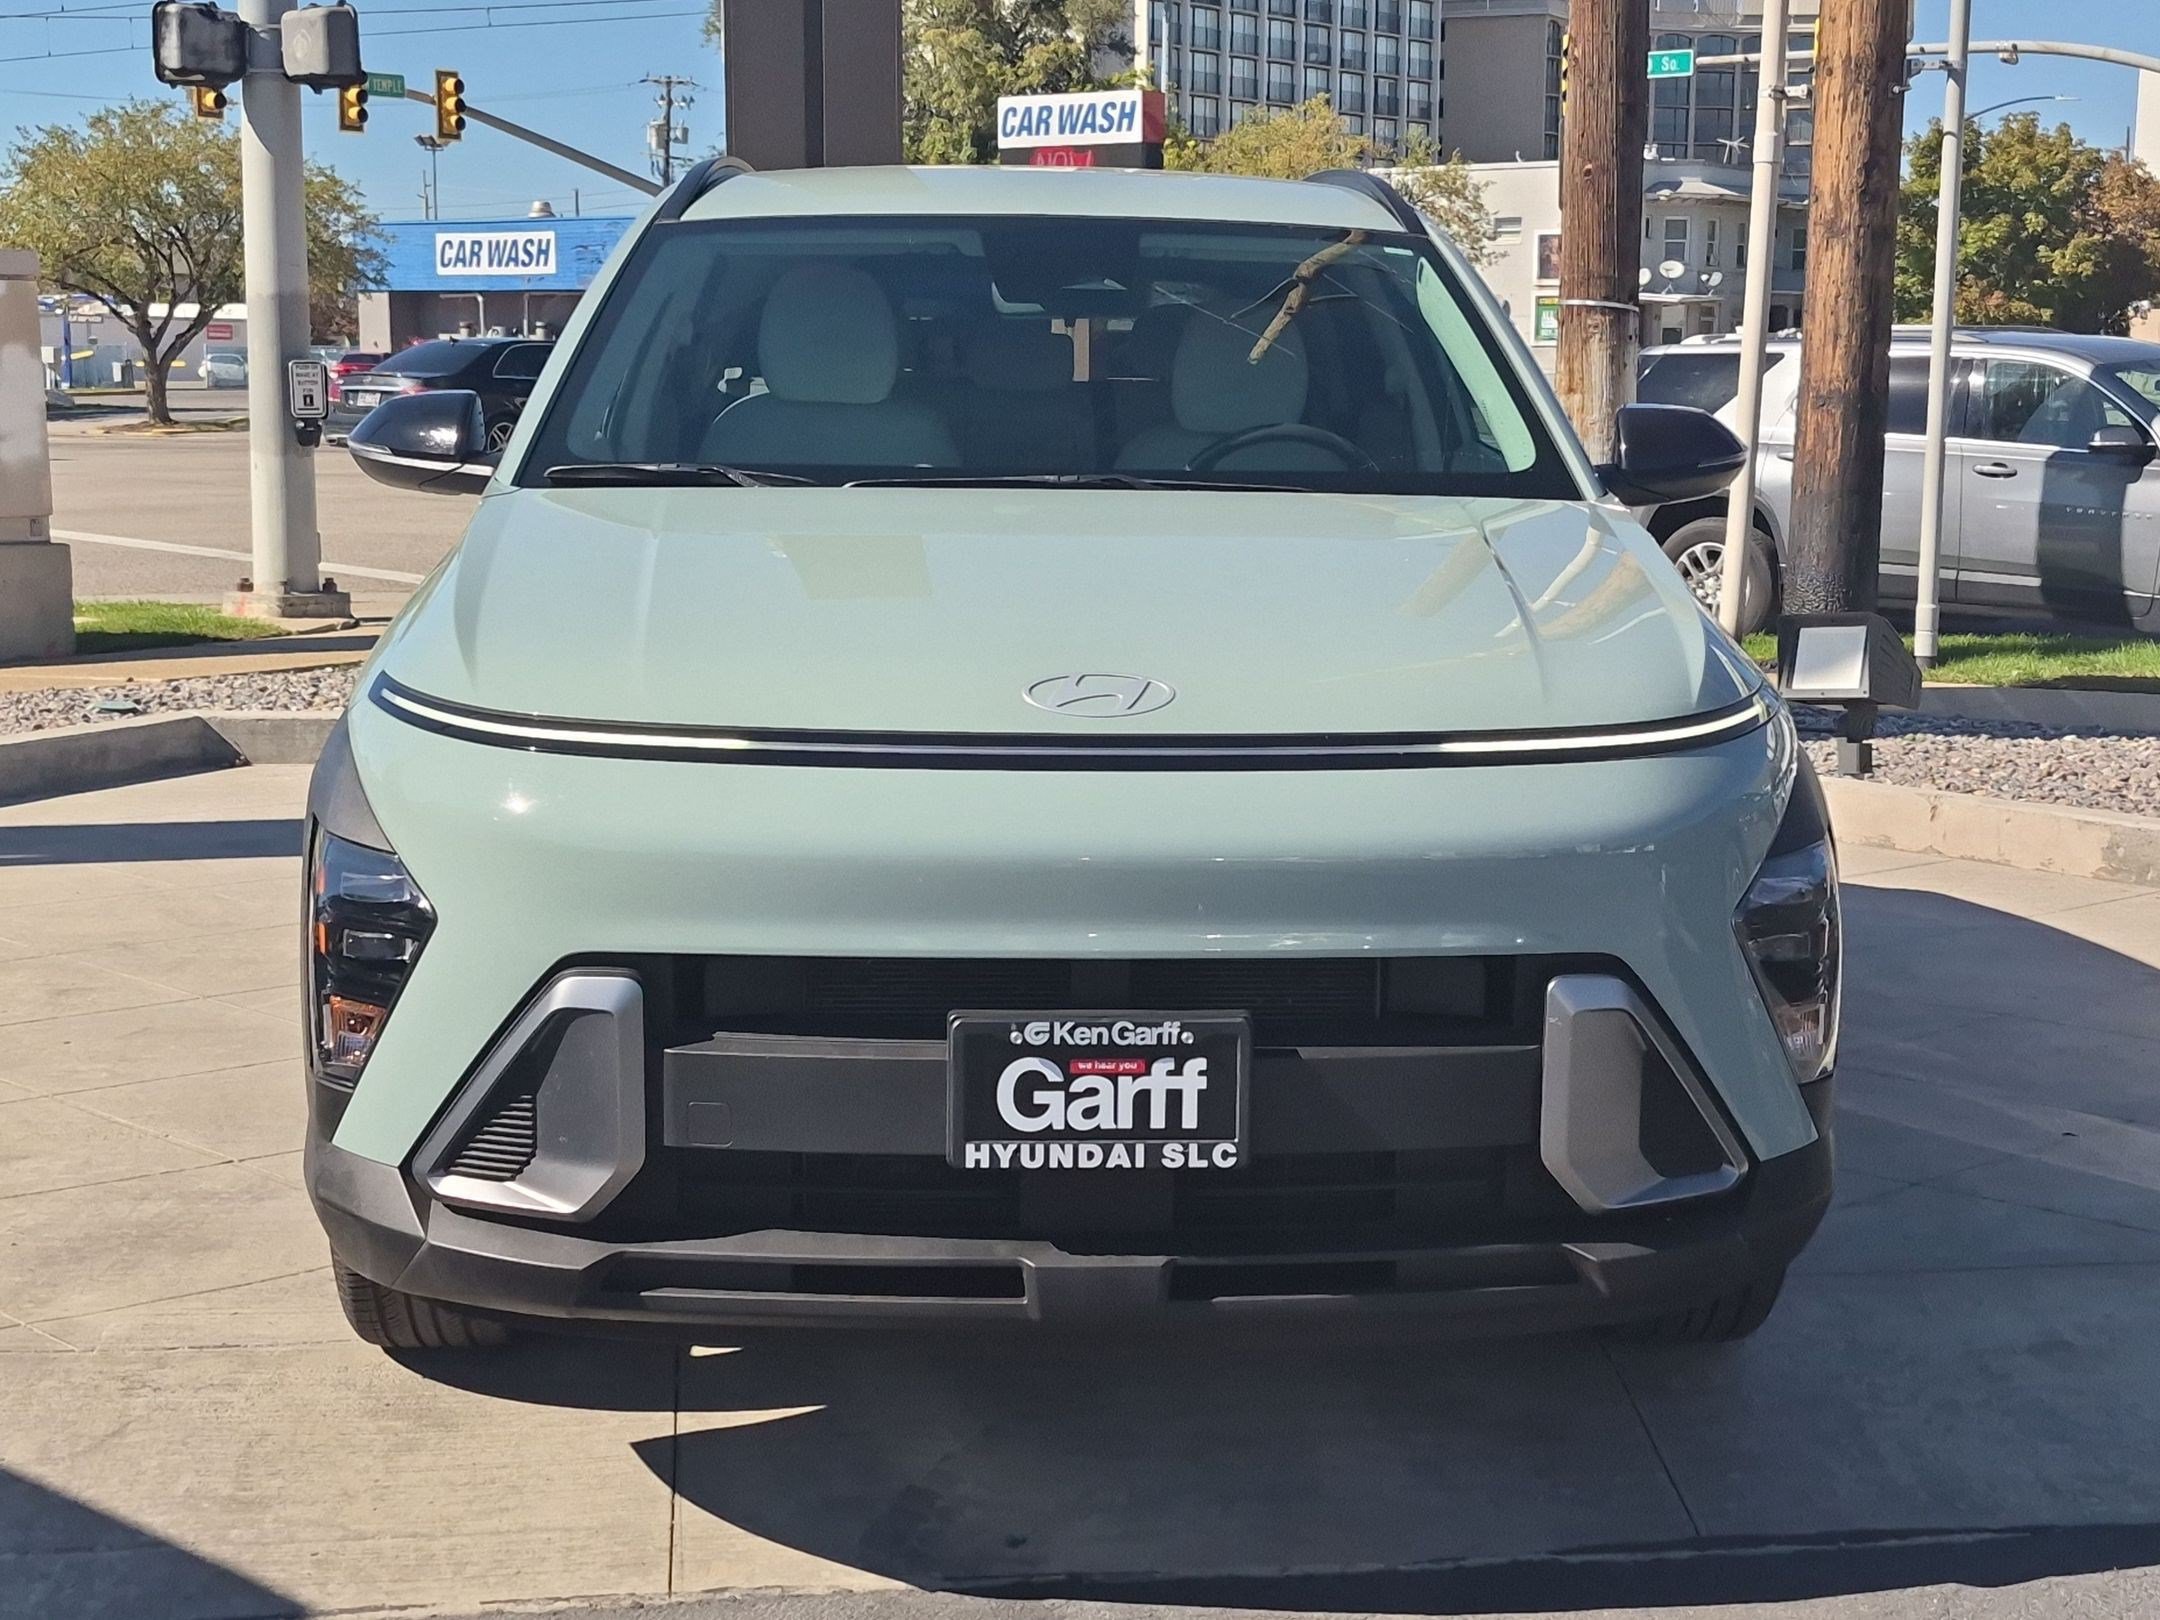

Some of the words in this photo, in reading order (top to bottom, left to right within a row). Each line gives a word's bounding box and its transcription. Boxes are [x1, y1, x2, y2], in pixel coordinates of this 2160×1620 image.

[373, 78, 403, 94] TEMPLE
[1002, 105, 1053, 138] CAR
[1058, 100, 1137, 136] WASH
[440, 239, 483, 268] CAR
[487, 238, 552, 268] WASH
[1053, 1021, 1108, 1046] Ken
[1112, 1021, 1181, 1046] Garff
[1094, 1060, 1116, 1070] hear
[1118, 1062, 1138, 1072] you
[996, 1056, 1208, 1133] Garff
[964, 1143, 1145, 1169] HYUNDAI
[1161, 1143, 1238, 1168] SLC
